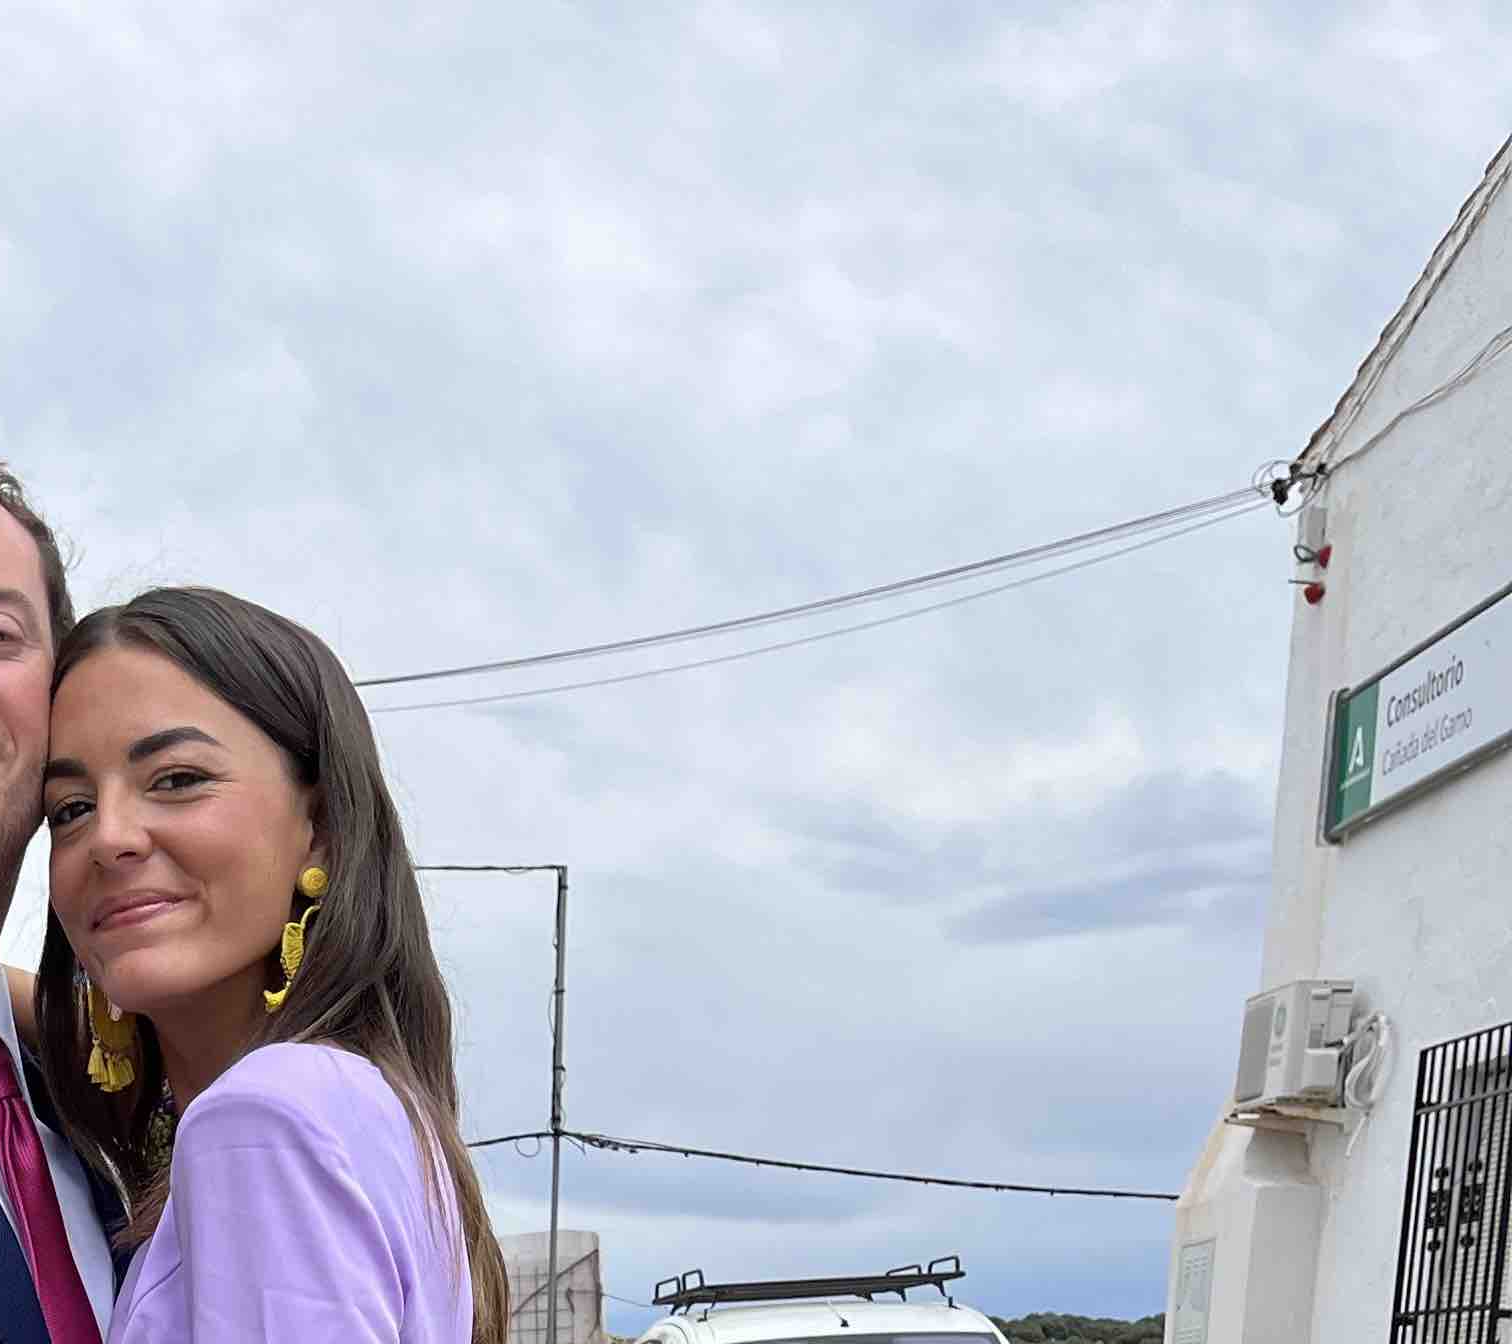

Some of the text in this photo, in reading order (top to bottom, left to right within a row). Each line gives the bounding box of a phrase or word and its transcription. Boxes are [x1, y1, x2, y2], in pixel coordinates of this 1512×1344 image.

[1386, 654, 1464, 728] Consultorio
[1420, 718, 1439, 753] del
[1439, 706, 1473, 742] Gamo
